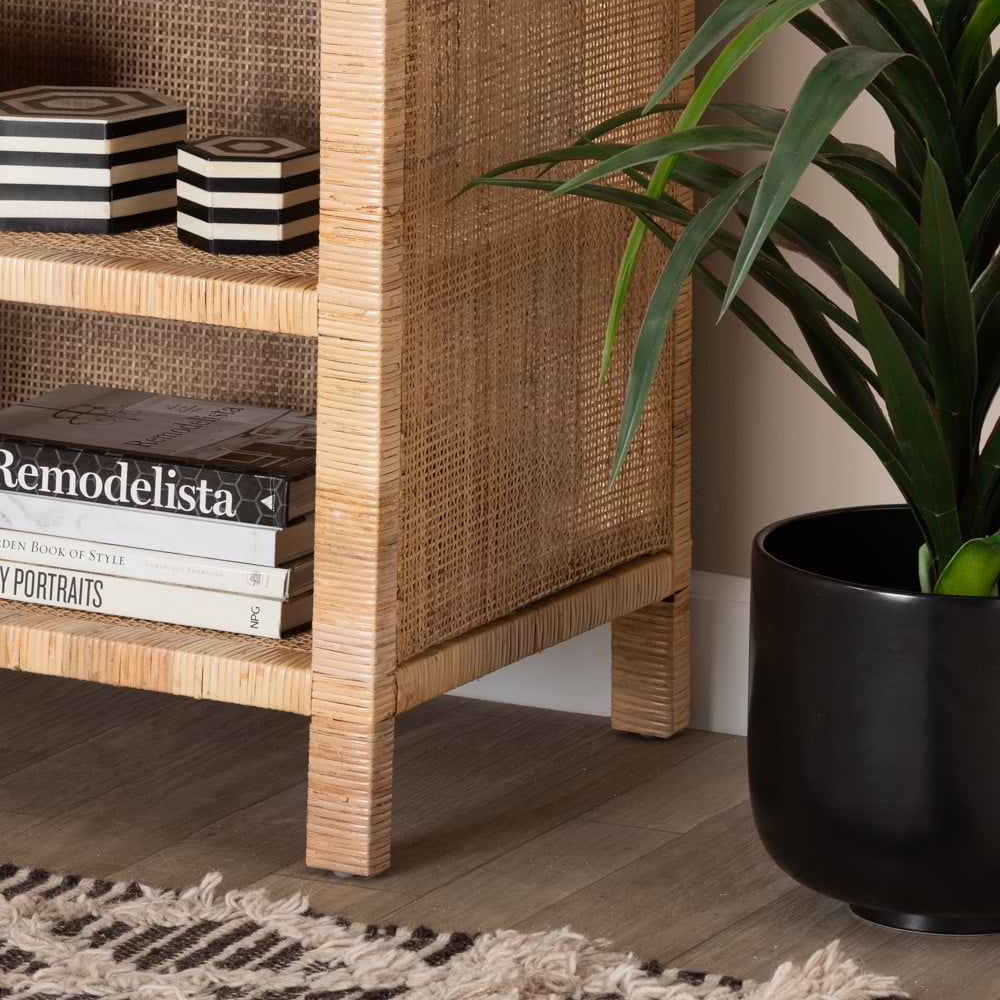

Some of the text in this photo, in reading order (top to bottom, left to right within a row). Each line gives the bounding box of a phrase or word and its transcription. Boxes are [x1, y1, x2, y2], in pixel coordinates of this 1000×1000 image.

[31, 540, 65, 557] BOOK
[69, 548, 85, 560] OF
[88, 549, 126, 565] STYLE
[13, 567, 104, 609] PORTRAITS
[249, 606, 261, 630] NPG
